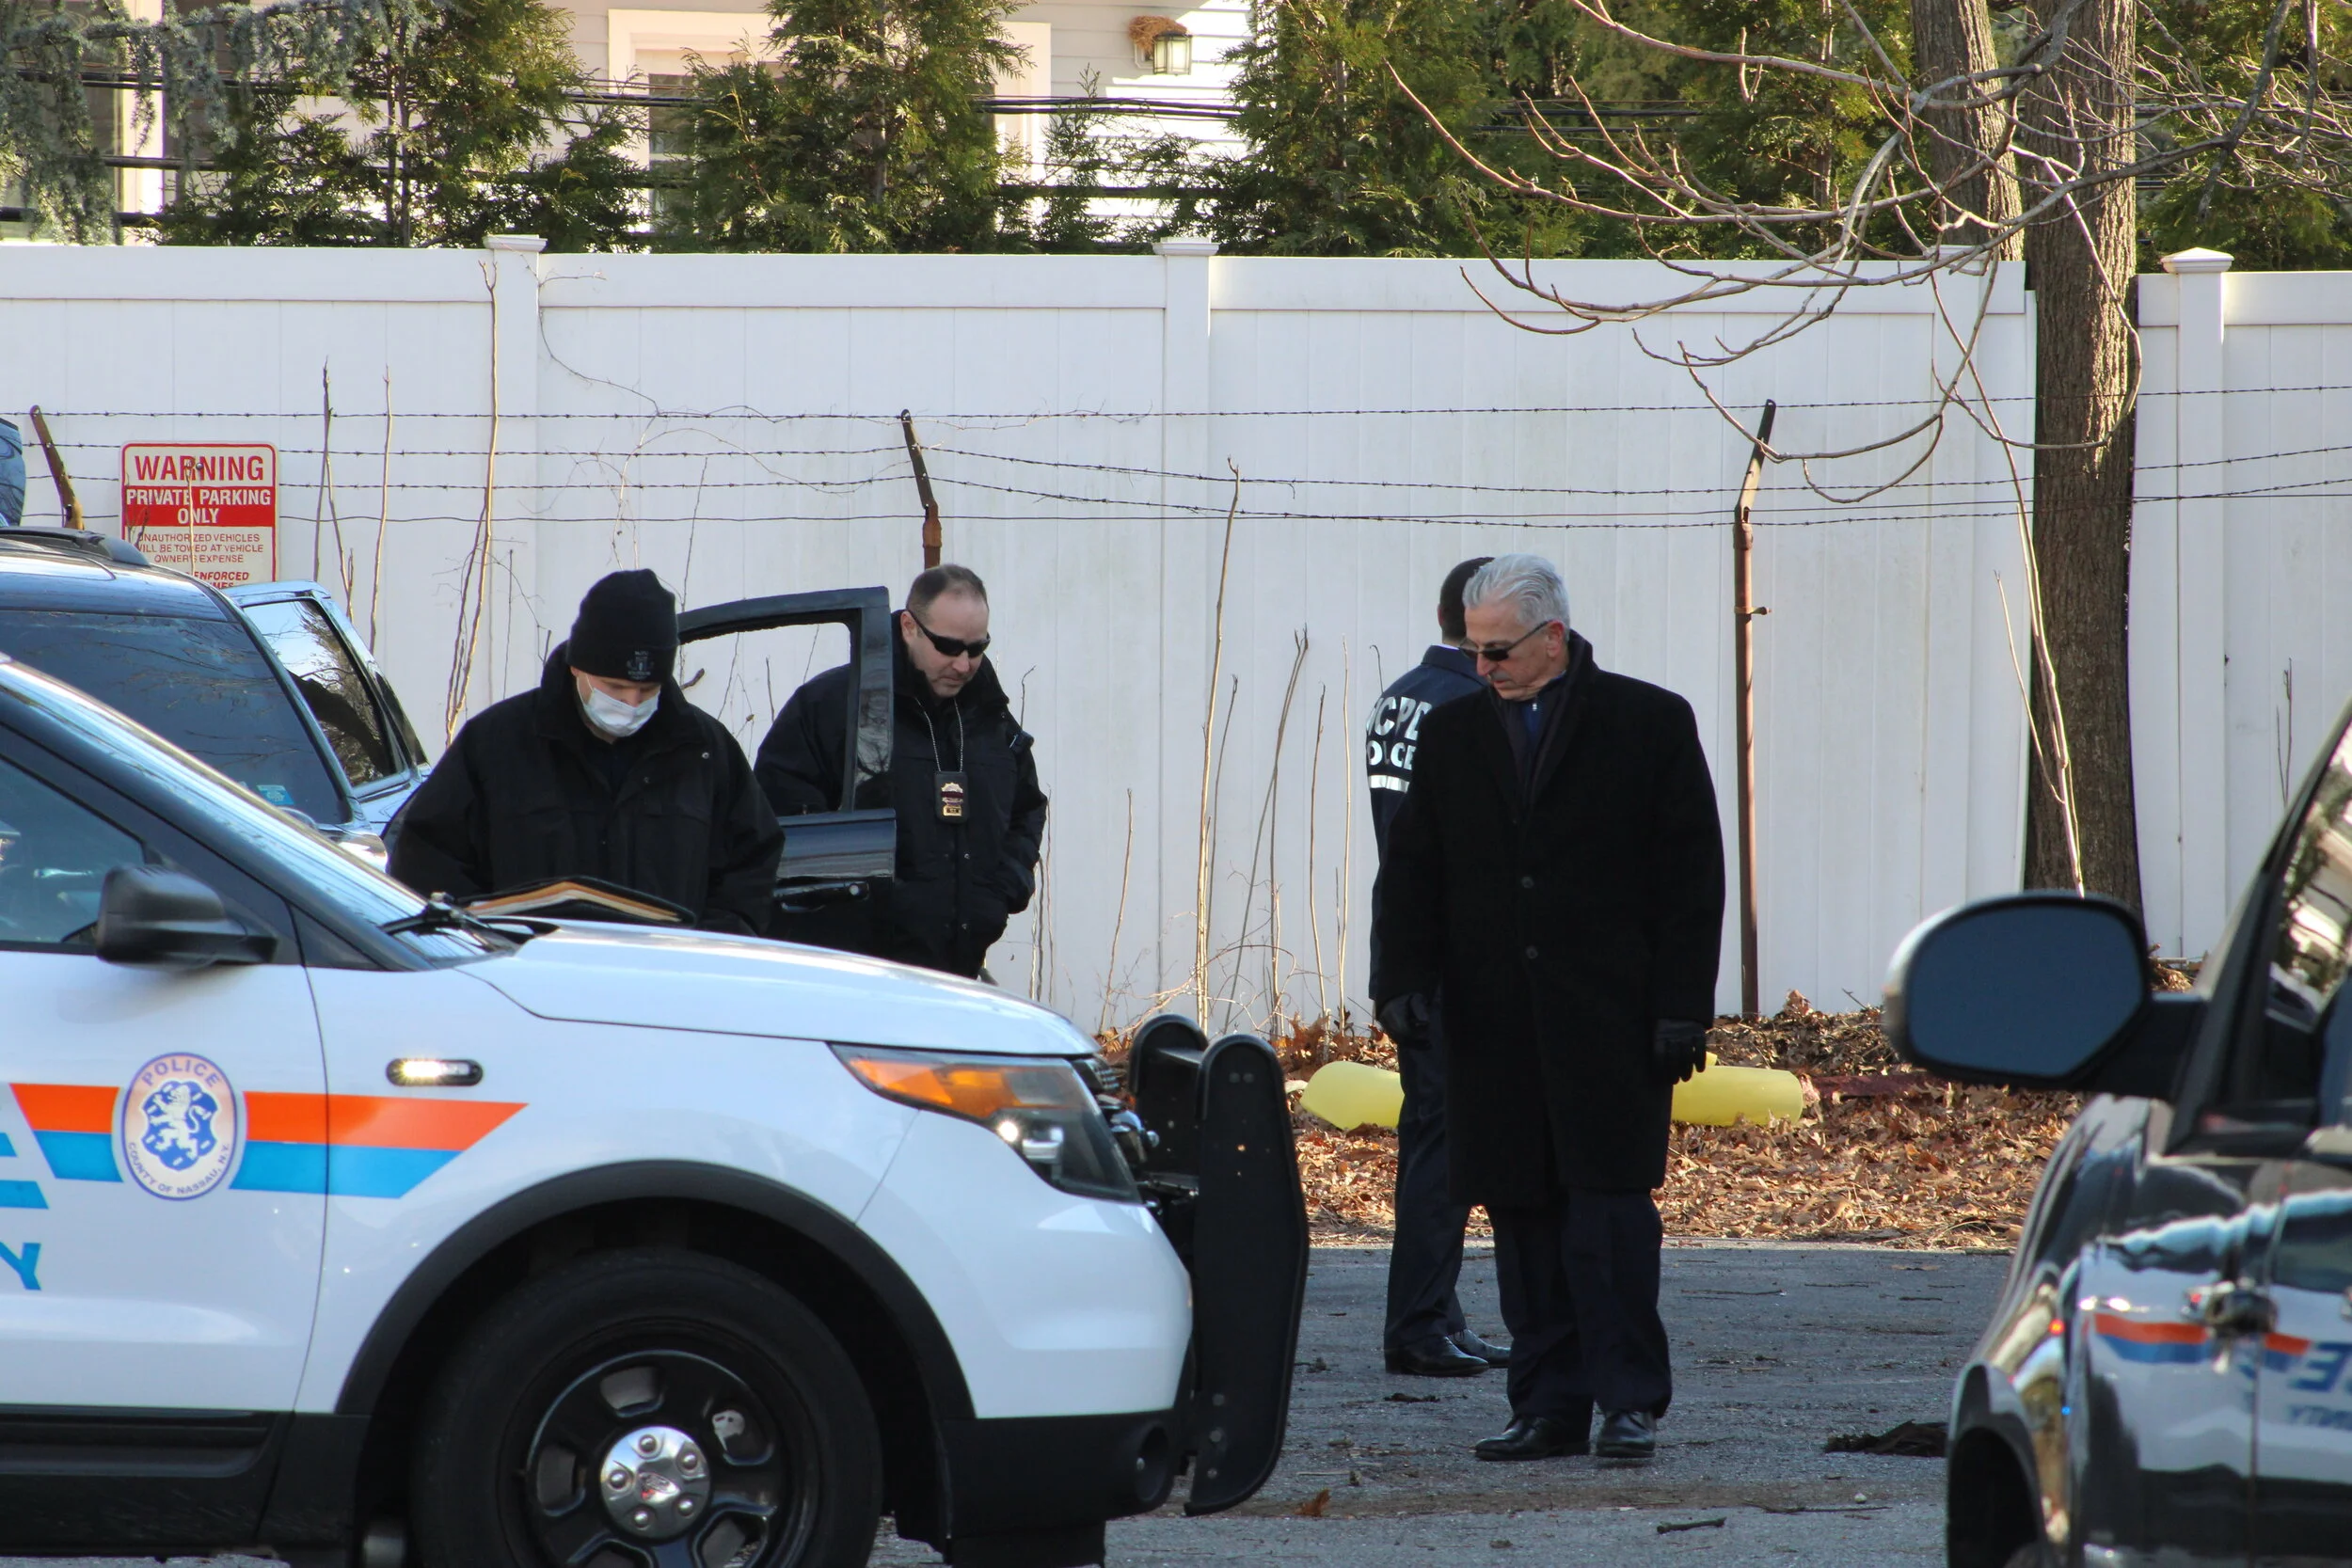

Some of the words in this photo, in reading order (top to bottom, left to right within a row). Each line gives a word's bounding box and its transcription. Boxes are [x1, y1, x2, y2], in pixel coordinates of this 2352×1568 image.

[135, 455, 263, 481] WARNING
[126, 488, 191, 506] PRIVATE
[199, 488, 271, 506] PARKING
[177, 508, 219, 524] ONLY
[138, 533, 212, 542] UNAUTHORZED
[214, 533, 261, 542] VEHICLES
[159, 544, 172, 552] BE
[210, 544, 222, 552] AT
[224, 544, 263, 552] VEHICLE
[199, 554, 244, 562] EXPENSE
[194, 571, 250, 580] ENFORCED
[142, 1058, 220, 1087] POLICE
[128, 1142, 158, 1185] COUNTY
[157, 1182, 173, 1194] OF
